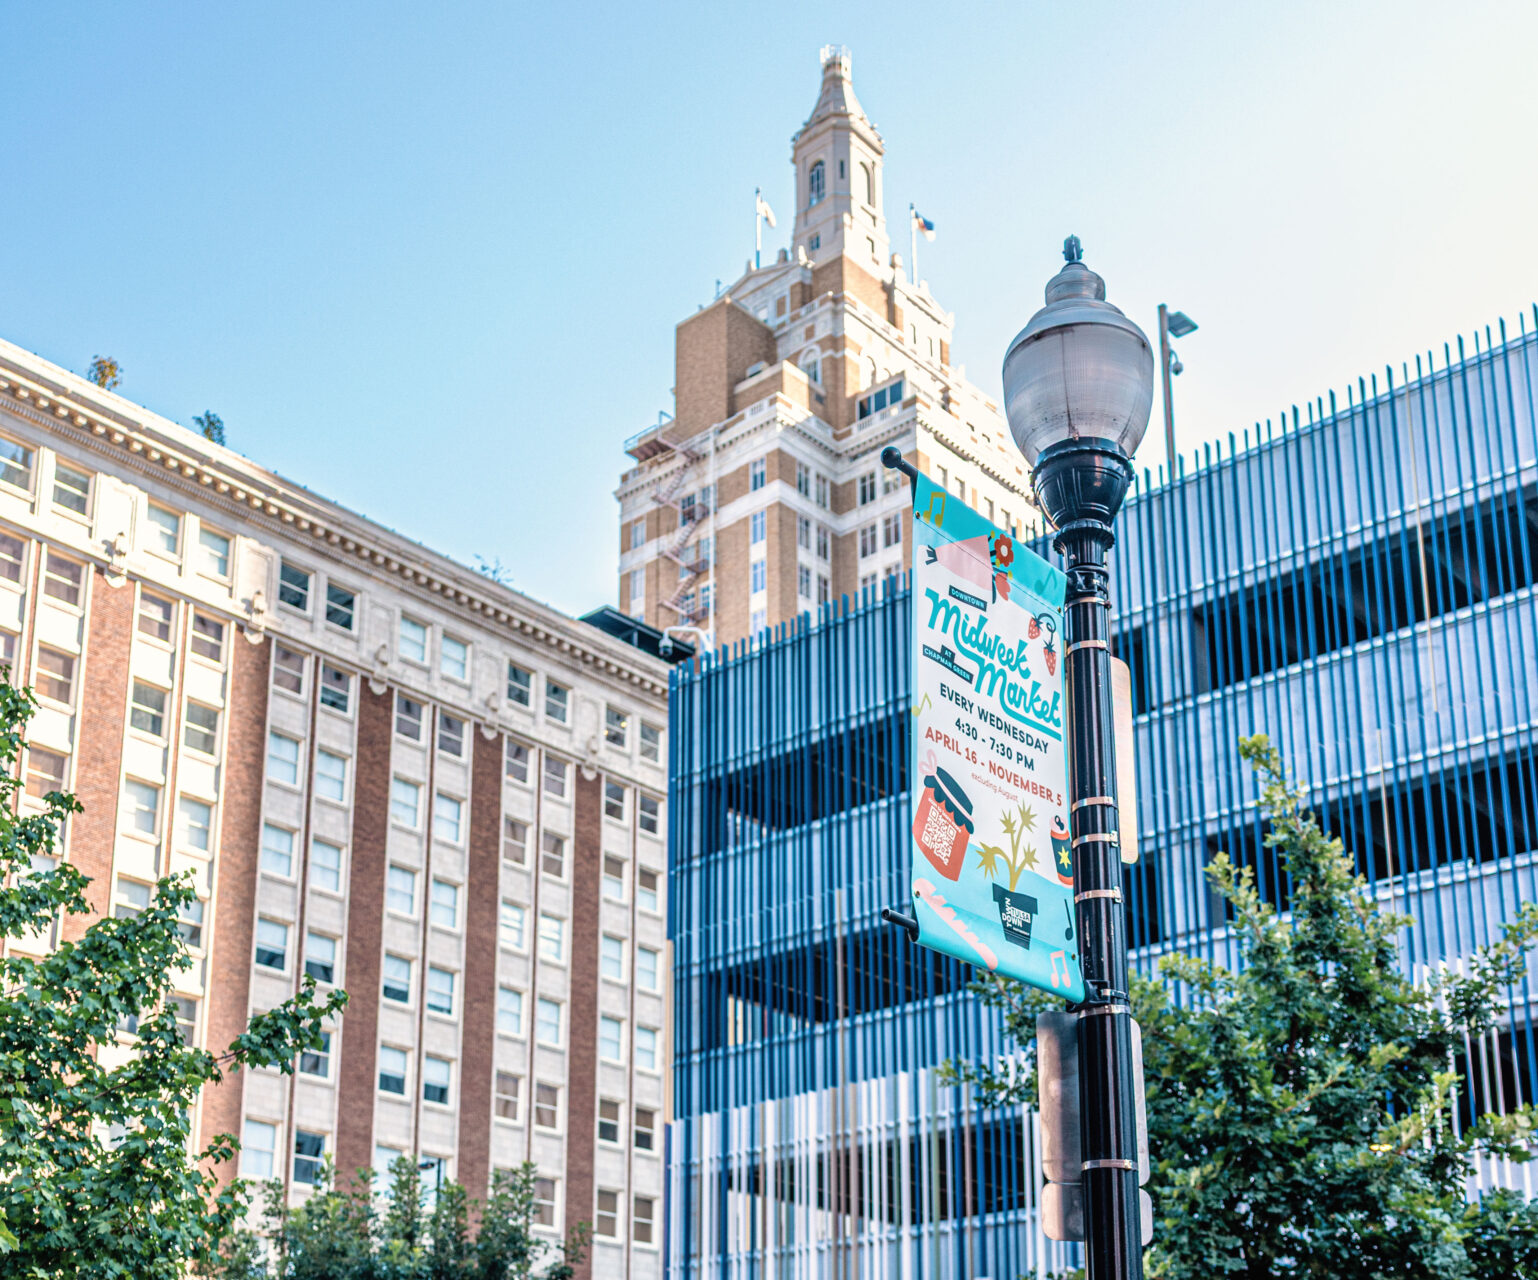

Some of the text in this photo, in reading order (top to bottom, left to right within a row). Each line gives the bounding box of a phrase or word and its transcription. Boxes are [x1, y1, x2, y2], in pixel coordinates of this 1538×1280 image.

[925, 587, 1031, 680] Midweek
[951, 588, 985, 609] DOWNTOWN
[923, 647, 971, 681] CHAPMAN GREEN
[973, 657, 1062, 732] Market
[940, 682, 1049, 754] EVERY WEDNESDAY
[955, 717, 978, 741] 4:30
[989, 736, 1013, 760] 7:30
[1016, 751, 1035, 772] PM
[925, 726, 962, 756] APRIL
[964, 747, 978, 766] 16
[988, 759, 1054, 803] NOVEMBER
[1056, 793, 1063, 807] 5
